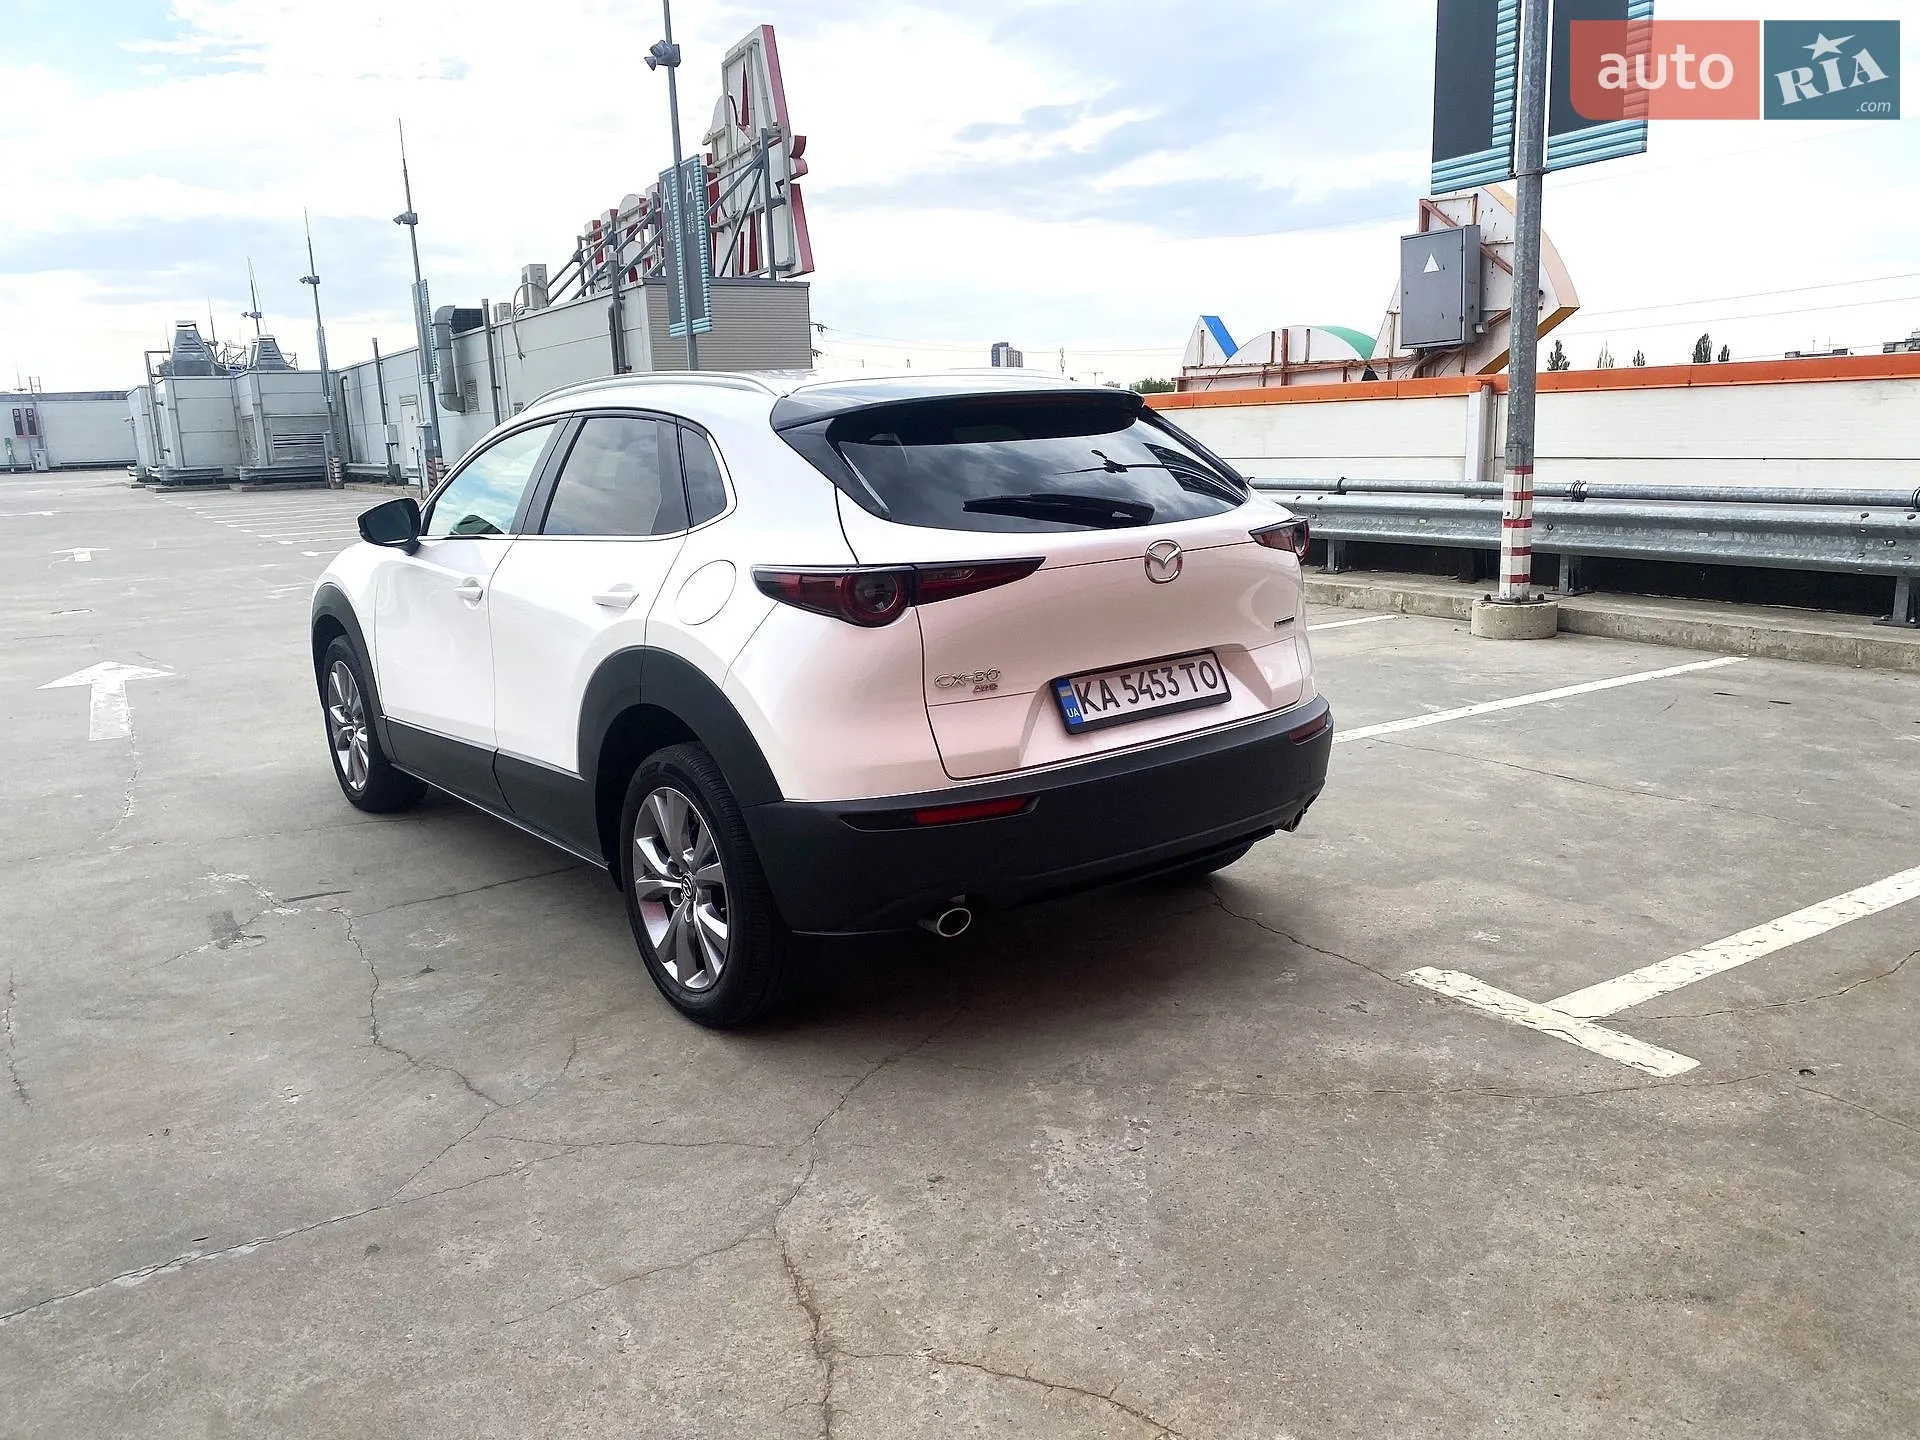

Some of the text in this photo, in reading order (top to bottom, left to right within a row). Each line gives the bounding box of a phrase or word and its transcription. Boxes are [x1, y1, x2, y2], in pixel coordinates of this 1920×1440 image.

[662, 180, 672, 213] A
[685, 169, 695, 204] A
[934, 668, 1000, 688] CX-30
[1075, 660, 1218, 714] KA 5453 TO
[1067, 708, 1081, 718] UA
